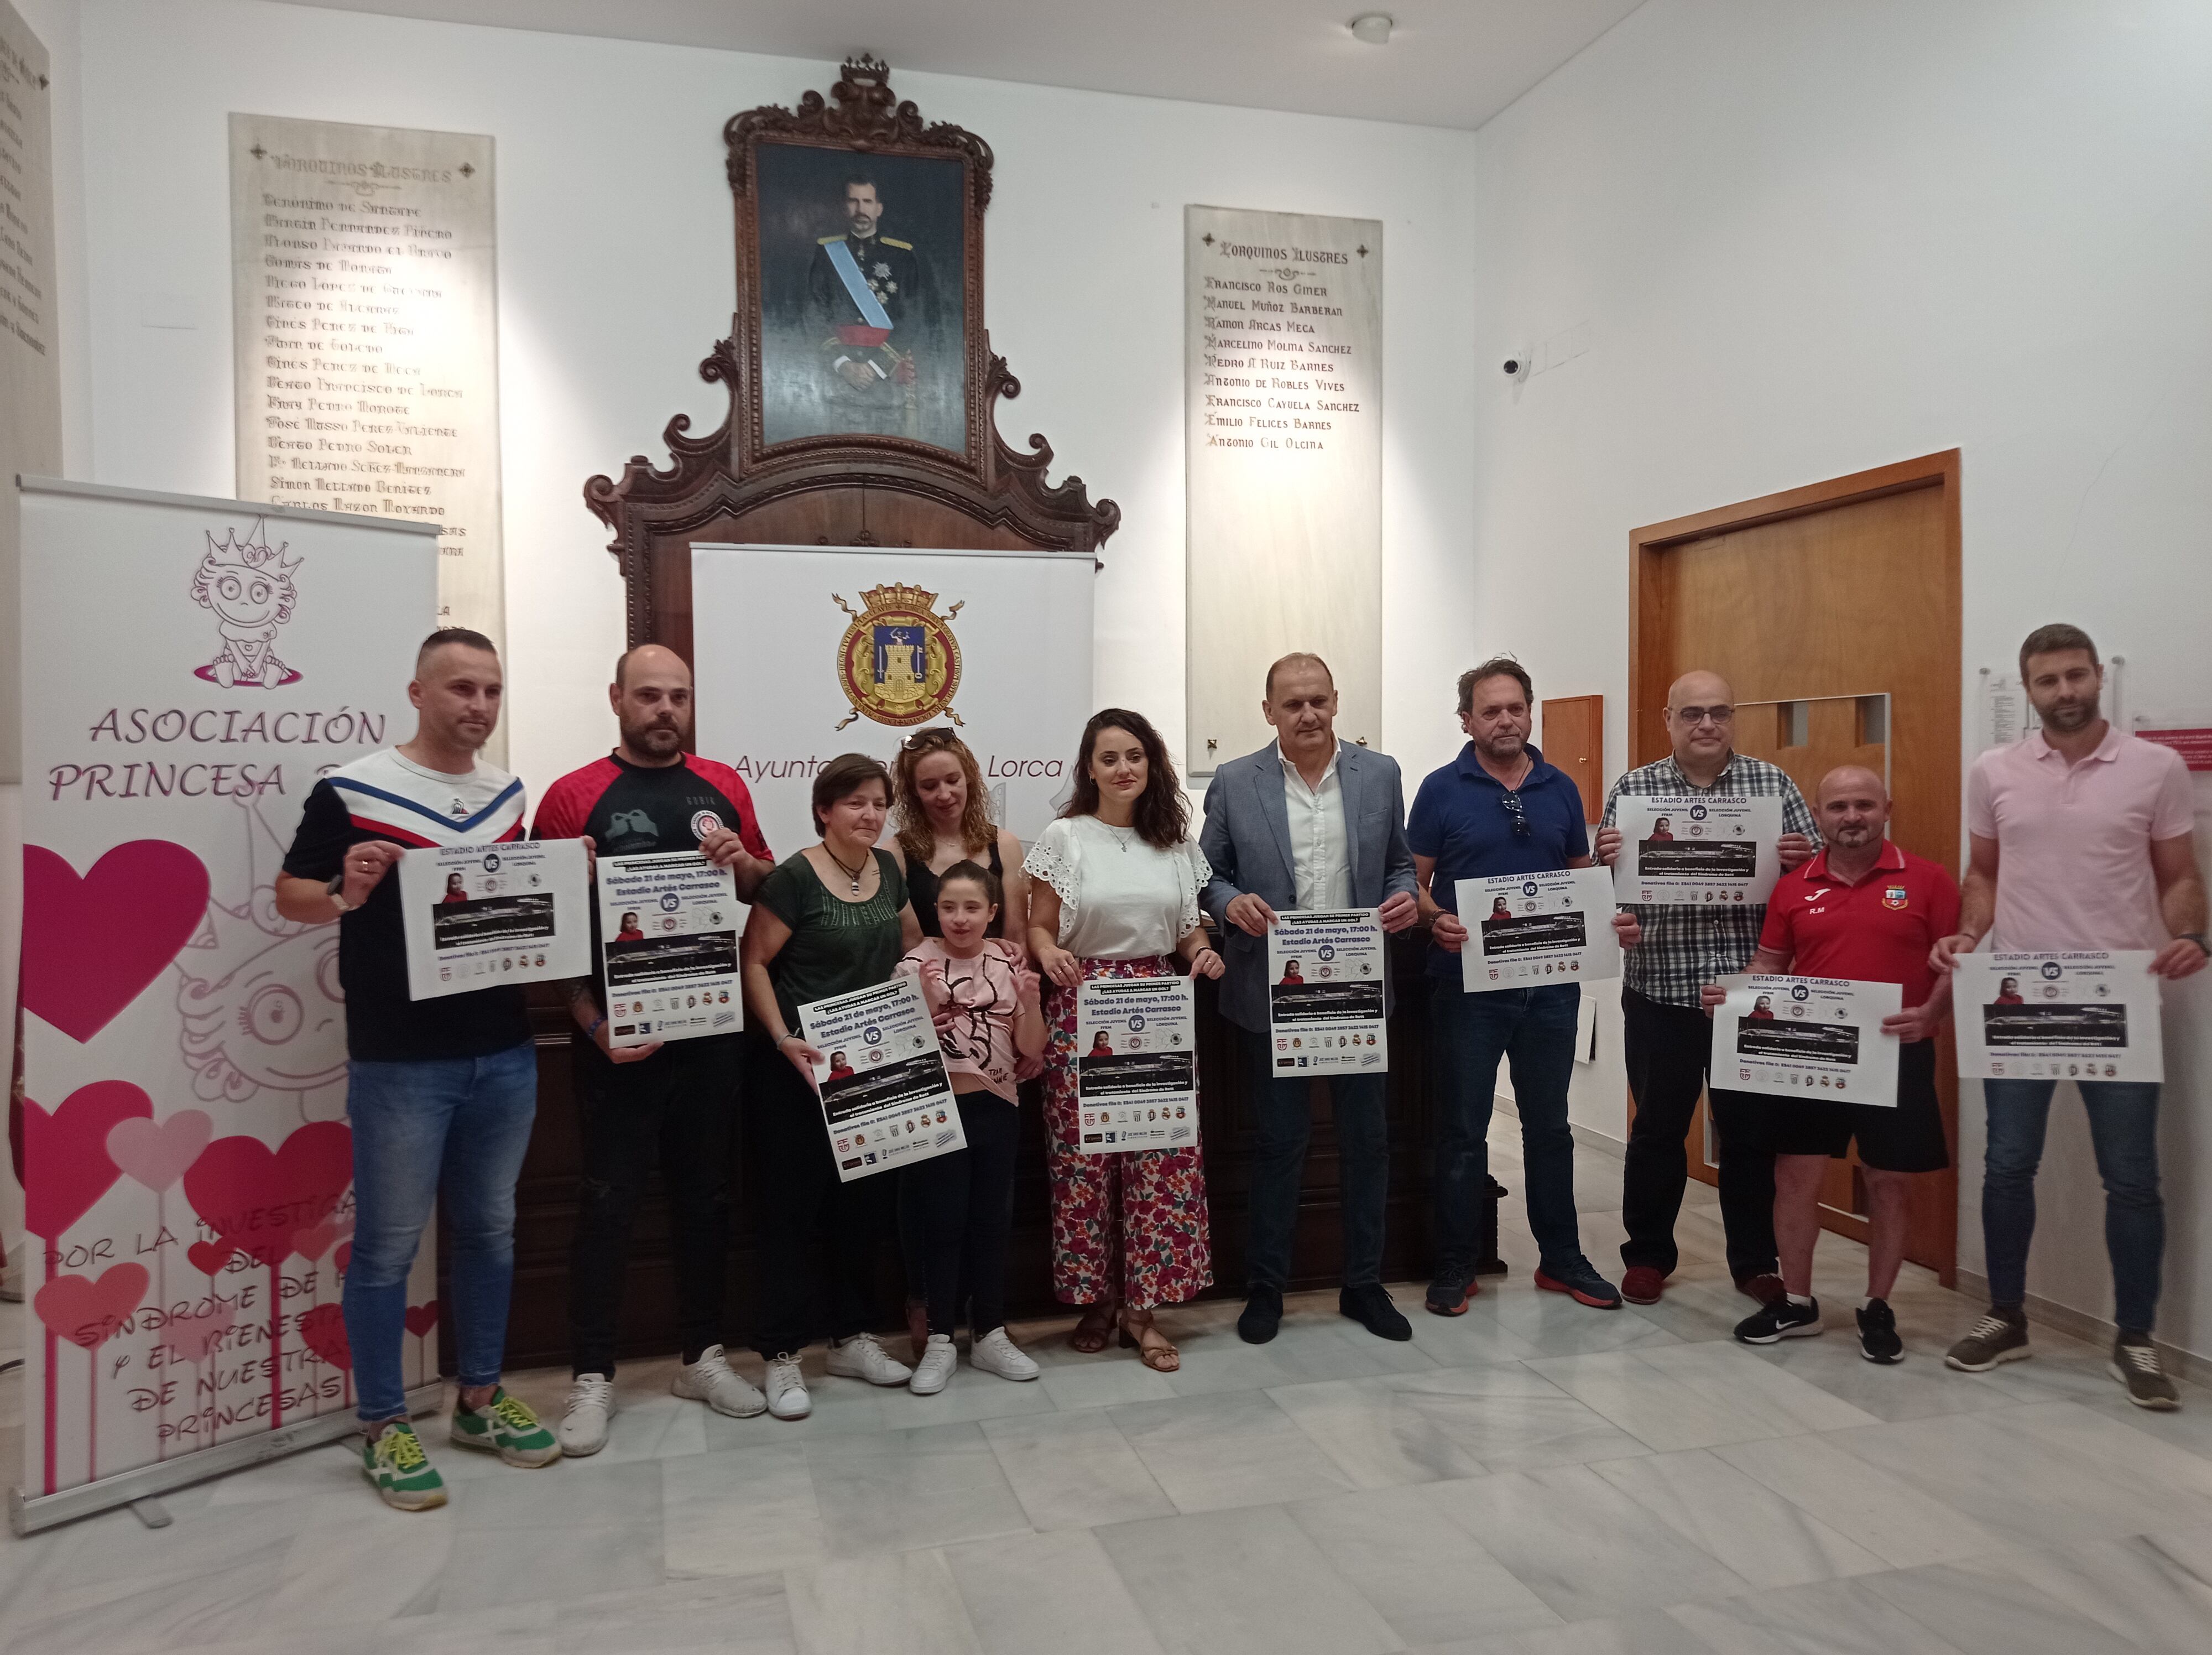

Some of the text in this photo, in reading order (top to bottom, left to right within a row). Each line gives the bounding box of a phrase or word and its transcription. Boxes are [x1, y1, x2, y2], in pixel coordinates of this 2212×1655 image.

[1205, 277, 1261, 292] FRANCISCO
[1267, 281, 1287, 294] ROS
[1249, 319, 1281, 332] ARCAS
[1287, 321, 1315, 334] MECA
[1308, 342, 1352, 355] SANCHEZ
[1261, 359, 1285, 369] RUIZ
[1291, 360, 1334, 372] BARNES
[1256, 379, 1267, 388] DE
[1272, 378, 1308, 390] ROBLES
[1316, 379, 1344, 392] VIVES
[1206, 394, 1359, 412] FRANCISCO CAYUELA SANCHEZ
[1249, 416, 1288, 429] FELICES
[1294, 418, 1332, 430] BARNES
[90, 706, 386, 744] ASOCIACIÓN
[988, 755, 1063, 777] Lorca
[49, 762, 287, 801] PRINCESA
[663, 899, 677, 909] VS
[1321, 950, 1332, 958] VS
[1810, 979, 1849, 987] CARRASCO
[810, 1016, 843, 1029] Sábado
[865, 1004, 891, 1014] mayo,
[891, 996, 911, 1007] 17:00
[821, 1007, 915, 1038] Estadio Artés Carrasco
[1131, 1020, 1142, 1029] VS
[866, 1032, 879, 1042] VS
[43, 1238, 114, 1267] POR
[137, 1226, 179, 1255] LA
[278, 1271, 318, 1298] DE
[148, 1345, 185, 1369] EL
[127, 1381, 179, 1411] DE
